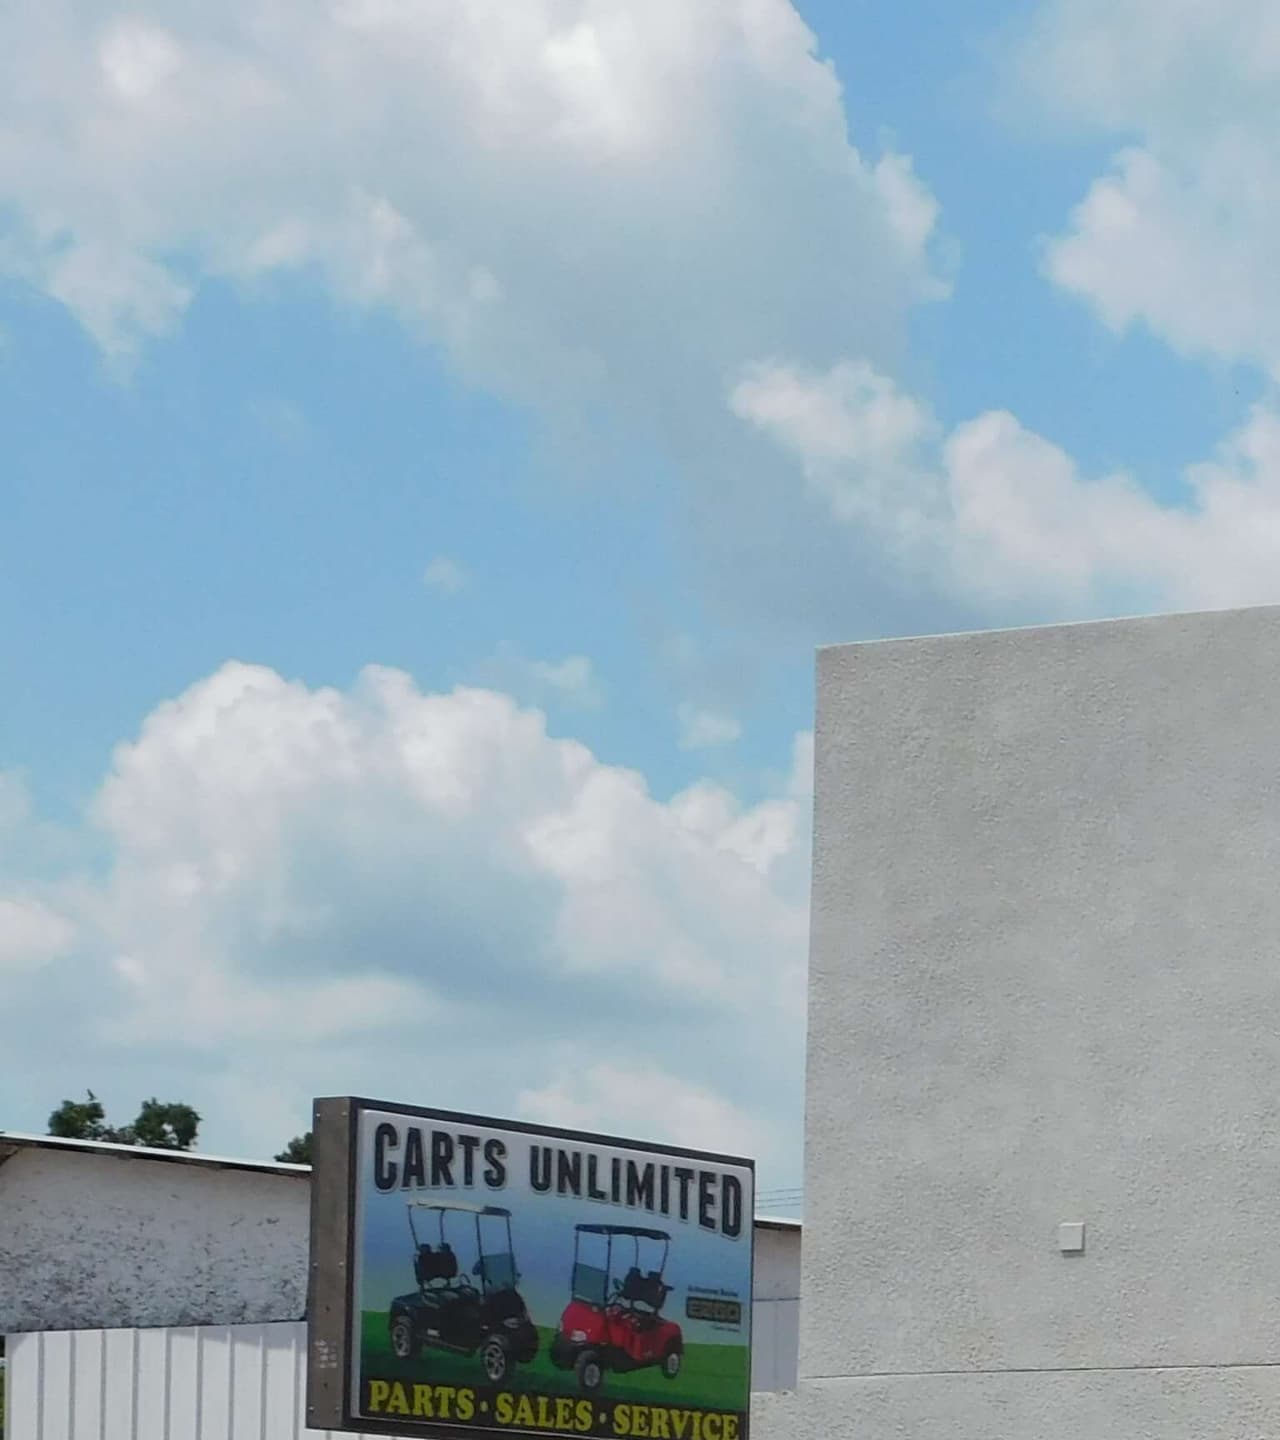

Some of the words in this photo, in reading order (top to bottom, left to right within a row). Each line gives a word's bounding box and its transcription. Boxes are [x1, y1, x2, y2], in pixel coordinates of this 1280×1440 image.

[373, 1122, 507, 1192] CARTS
[530, 1144, 743, 1240] UNLIMITED
[368, 1380, 475, 1421] PARTS
[495, 1391, 593, 1432] SALES
